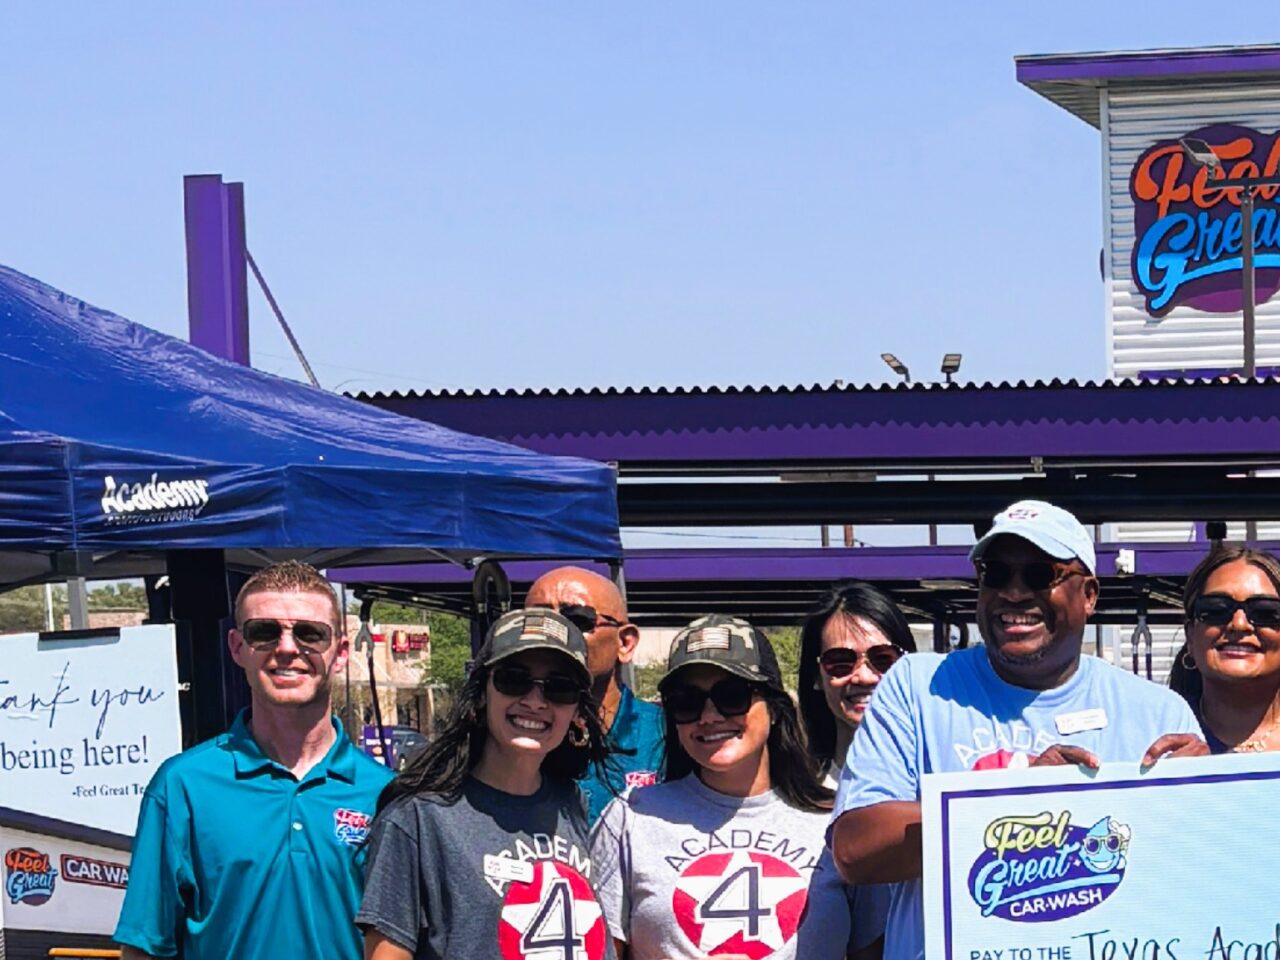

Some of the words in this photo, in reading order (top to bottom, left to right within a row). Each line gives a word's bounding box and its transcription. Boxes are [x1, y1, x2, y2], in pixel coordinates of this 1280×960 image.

[101, 472, 209, 514] Academy
[0, 661, 80, 729] ank
[90, 686, 165, 741] you
[1, 739, 76, 775] being
[82, 734, 150, 767] here!
[72, 785, 97, 798] -Feel
[99, 782, 129, 798] Great
[663, 829, 824, 873] ACADEMY
[983, 810, 1072, 860] Feel
[5, 848, 50, 873] Feel
[66, 859, 102, 881] CAR
[103, 865, 129, 884] WA
[974, 842, 1090, 916] Great
[8, 866, 59, 903] Great
[700, 866, 771, 937] 4
[1036, 946, 1072, 960] THE
